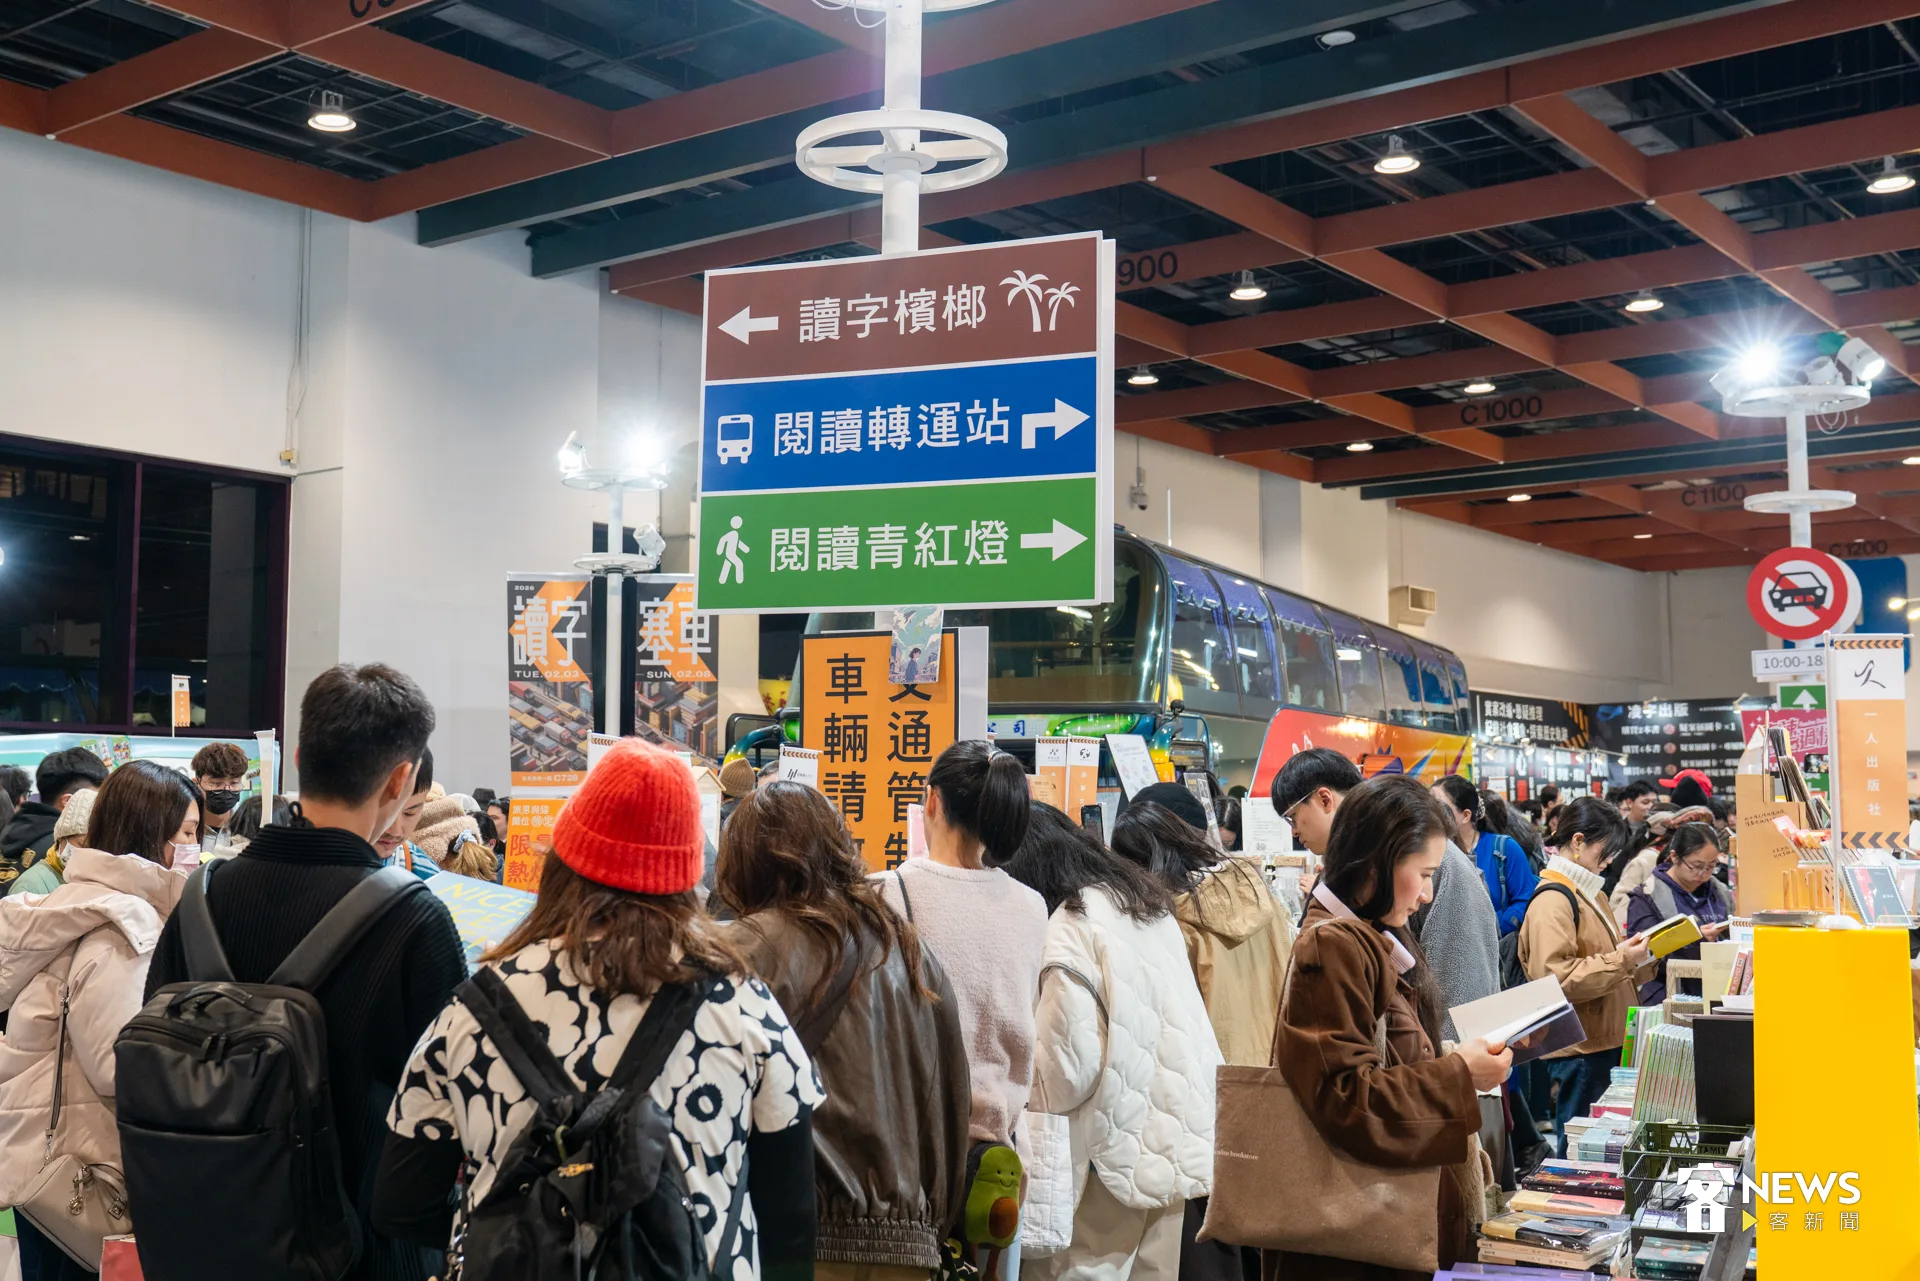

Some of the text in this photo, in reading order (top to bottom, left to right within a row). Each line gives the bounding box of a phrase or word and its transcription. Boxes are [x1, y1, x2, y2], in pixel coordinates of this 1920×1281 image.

[799, 283, 987, 343] 讀字檳榔
[773, 398, 1010, 457] 閱讀轉運站
[770, 520, 1010, 573] 閱讀青紅燈
[513, 595, 587, 667] 讀字
[637, 597, 712, 666] 塞車
[1863, 712, 1882, 817] 一人出版社
